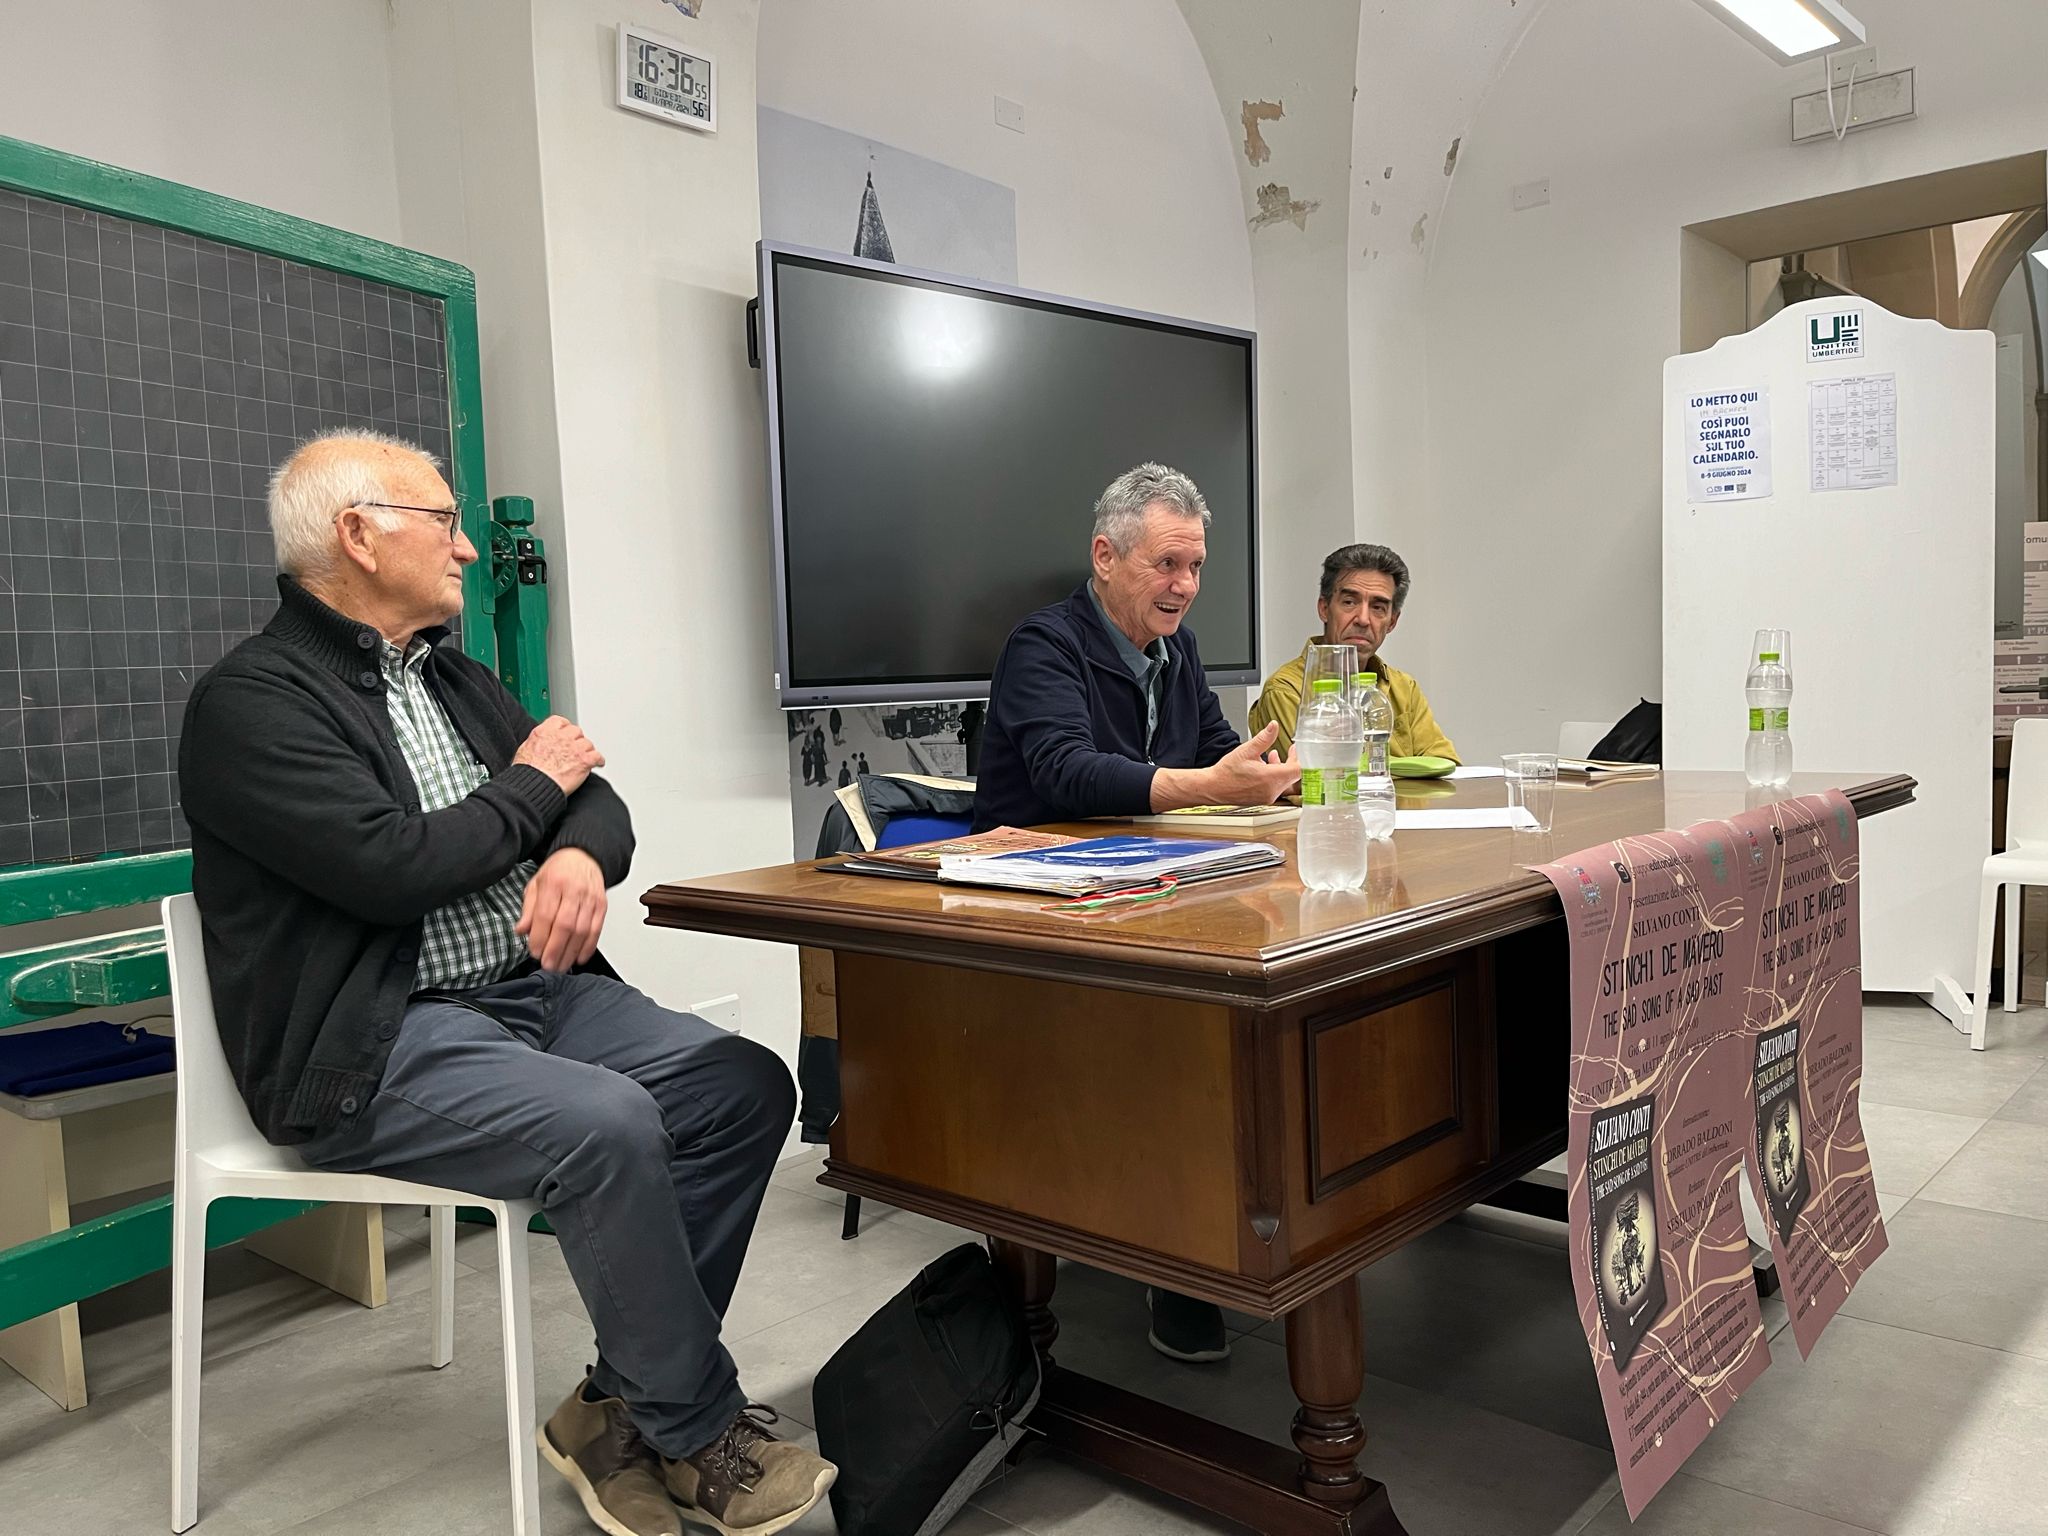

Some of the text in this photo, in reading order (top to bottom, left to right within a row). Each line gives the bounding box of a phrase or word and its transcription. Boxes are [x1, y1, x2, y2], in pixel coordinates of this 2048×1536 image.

[639, 44, 694, 96] 16:36
[1811, 341, 1859, 350] UNITRE
[1812, 347, 1859, 357] UMBERTIDE
[1691, 392, 1758, 408] LO METTO QUI
[1699, 427, 1751, 441] SEGNARLO
[1701, 416, 1749, 429] COSÌ PUOI
[1693, 450, 1759, 465] CALENDARIO.
[1705, 439, 1745, 452] SUL TUO
[1712, 470, 1736, 478] GIUGNO
[1783, 870, 1810, 891] SILVANO
[1633, 914, 1671, 938] SILVANO
[1672, 906, 1700, 929] CONTI
[1762, 900, 1799, 939] STINCHI
[1804, 894, 1815, 922] DE
[1762, 918, 1847, 974] THE SAD SONG OF A SAD PAST
[1603, 949, 1654, 997] STINCHI
[1662, 943, 1677, 976] DE
[1603, 972, 1724, 1039] THE SAD SONG OF A SAD PAST
[1594, 1104, 1651, 1153] SILVANO CONTI
[1663, 1120, 1733, 1167] CORRADO BALDONI
[1593, 1150, 1618, 1181] STINCHI
[1618, 1147, 1626, 1167] DE
[1595, 1183, 1605, 1201] THE
[1666, 1206, 1696, 1235] SESTILIO
